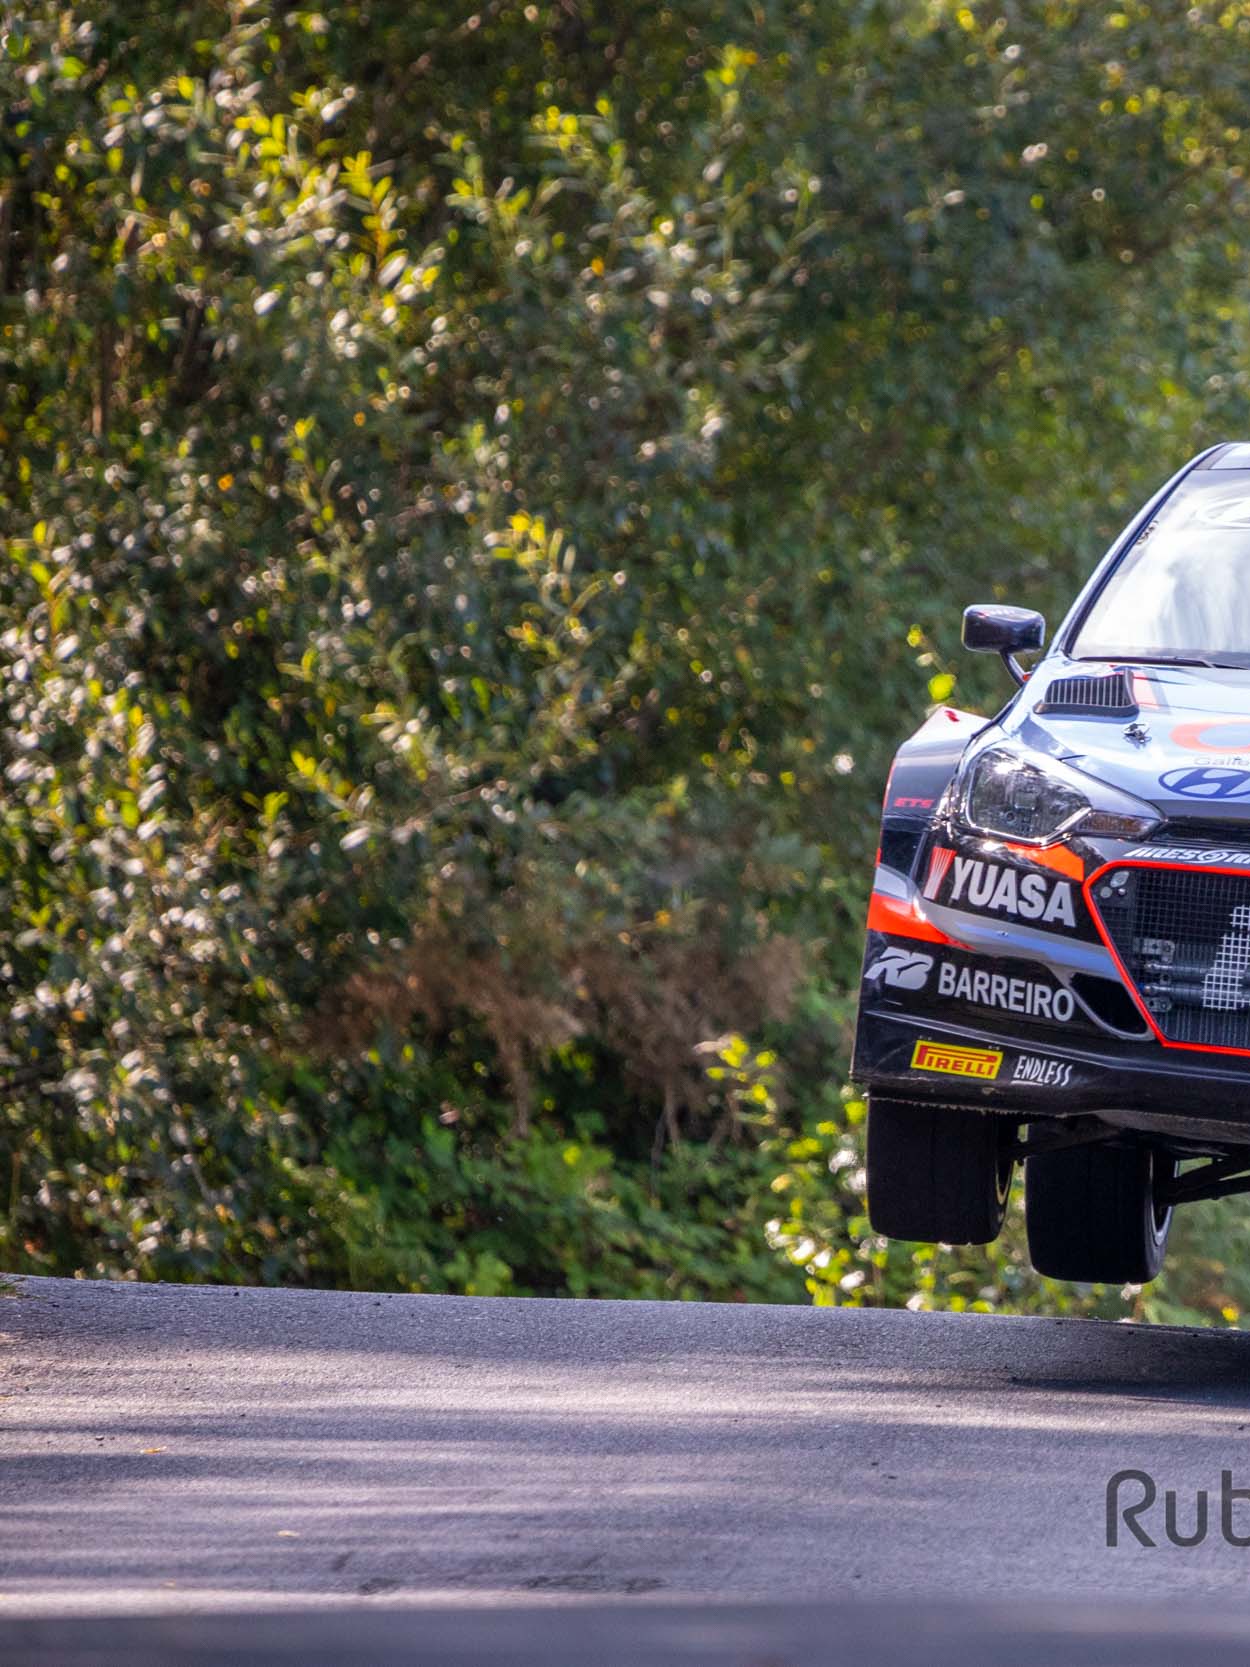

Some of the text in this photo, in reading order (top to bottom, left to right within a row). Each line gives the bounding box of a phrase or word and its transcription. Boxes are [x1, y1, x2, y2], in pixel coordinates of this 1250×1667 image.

[950, 857, 1077, 928] YUASA
[938, 962, 1074, 1022] BARREIRO
[915, 1044, 998, 1077] PIRELLI
[1012, 1055, 1073, 1087] ENDLESS
